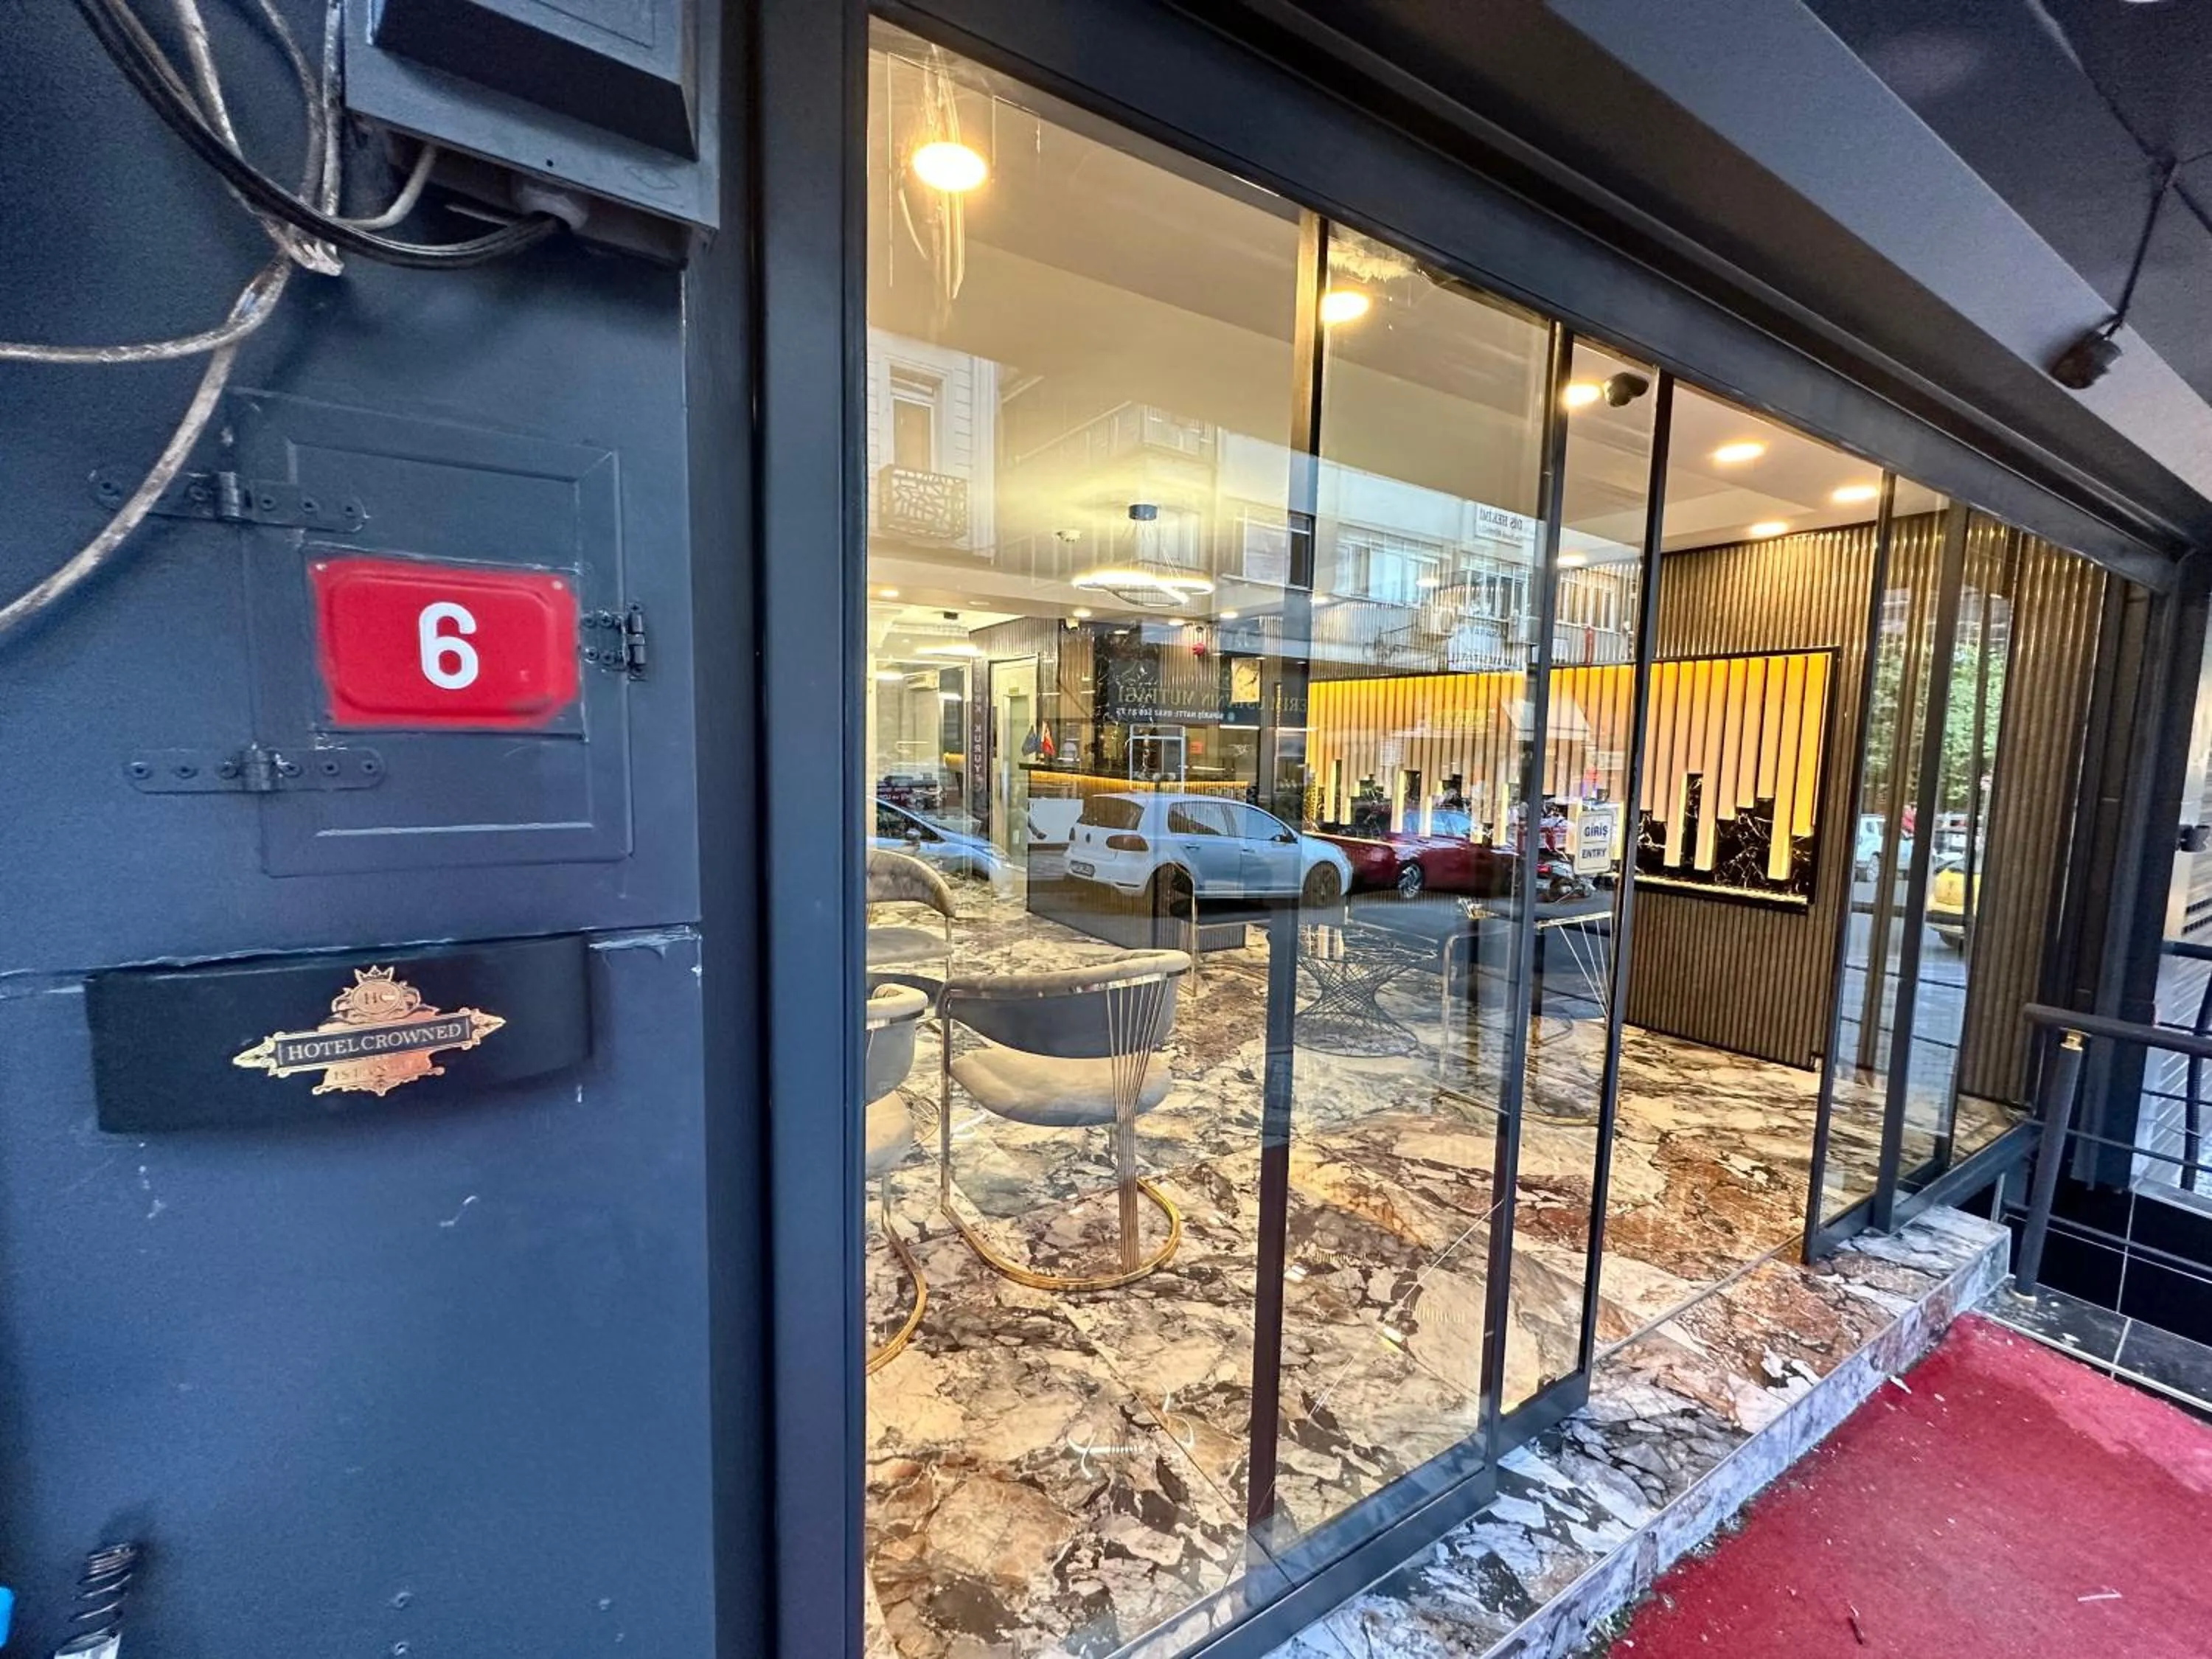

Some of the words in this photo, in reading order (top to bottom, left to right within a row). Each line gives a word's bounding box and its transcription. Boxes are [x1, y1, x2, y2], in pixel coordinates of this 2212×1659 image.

[418, 601, 479, 689] 6
[1585, 822, 1607, 838] GİRİŞ
[1582, 848, 1607, 859] ENTRY
[288, 1038, 359, 1061] HOTEL
[361, 1024, 462, 1051] CROWNED
